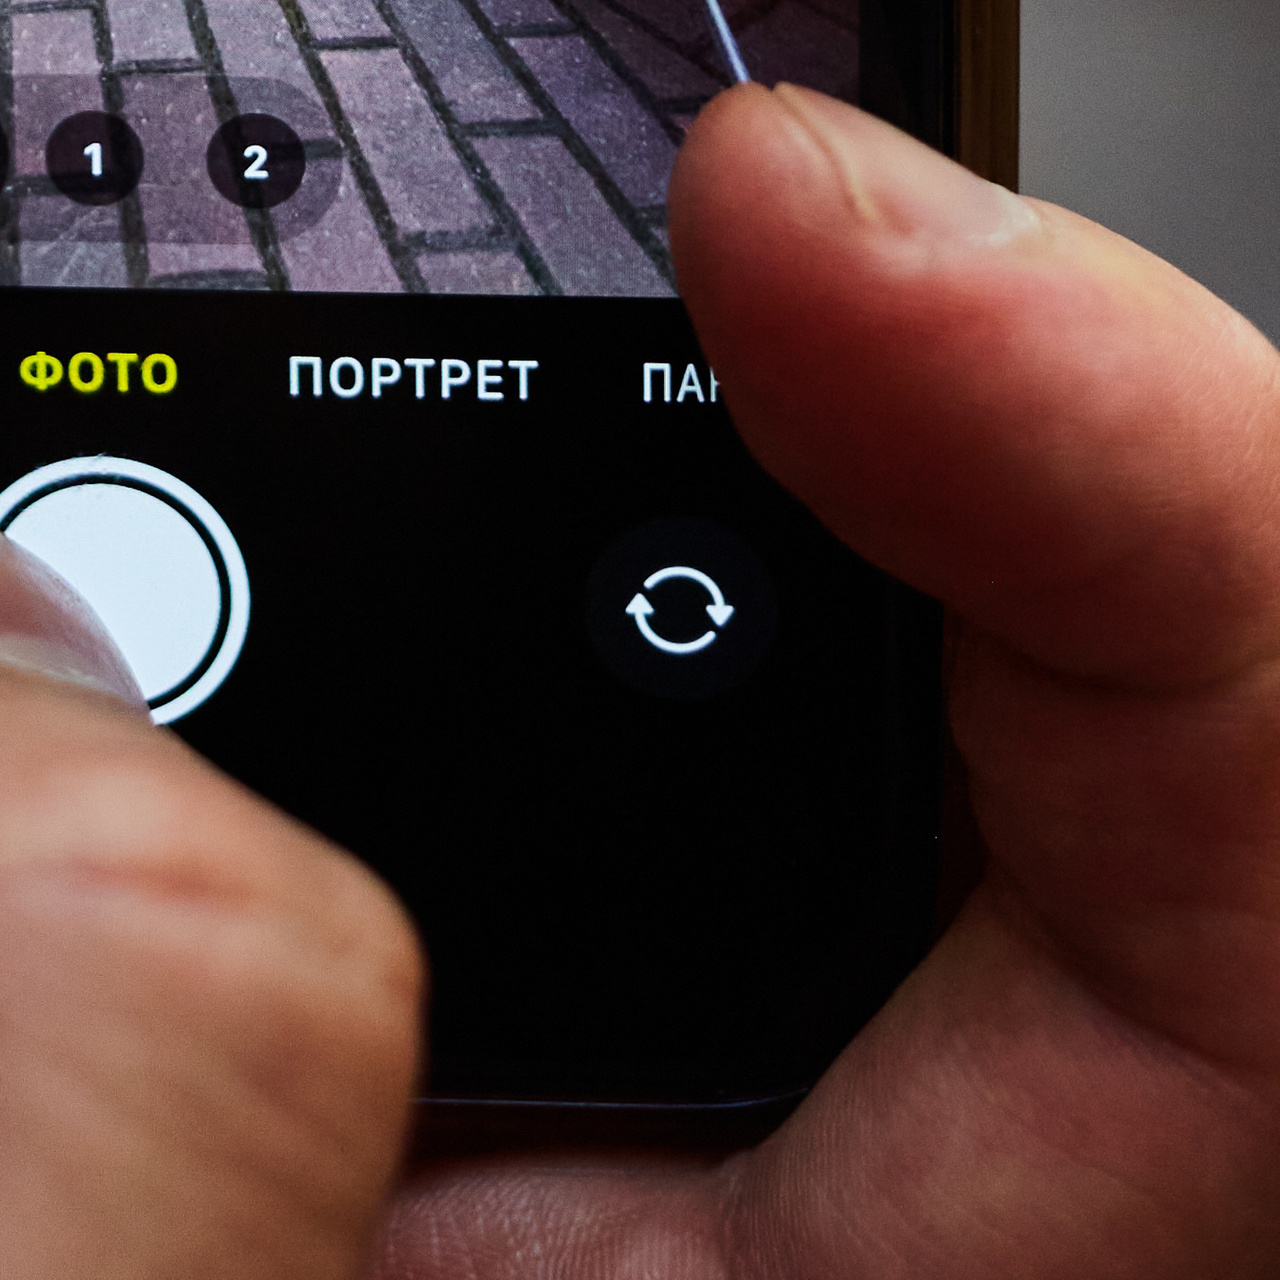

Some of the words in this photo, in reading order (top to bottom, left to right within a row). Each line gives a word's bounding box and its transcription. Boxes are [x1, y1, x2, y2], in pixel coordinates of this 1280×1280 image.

[83, 142, 103, 177] 1
[243, 144, 269, 180] 2
[19, 351, 178, 393] ФОТО
[289, 355, 540, 401] ПОРТРЕТ
